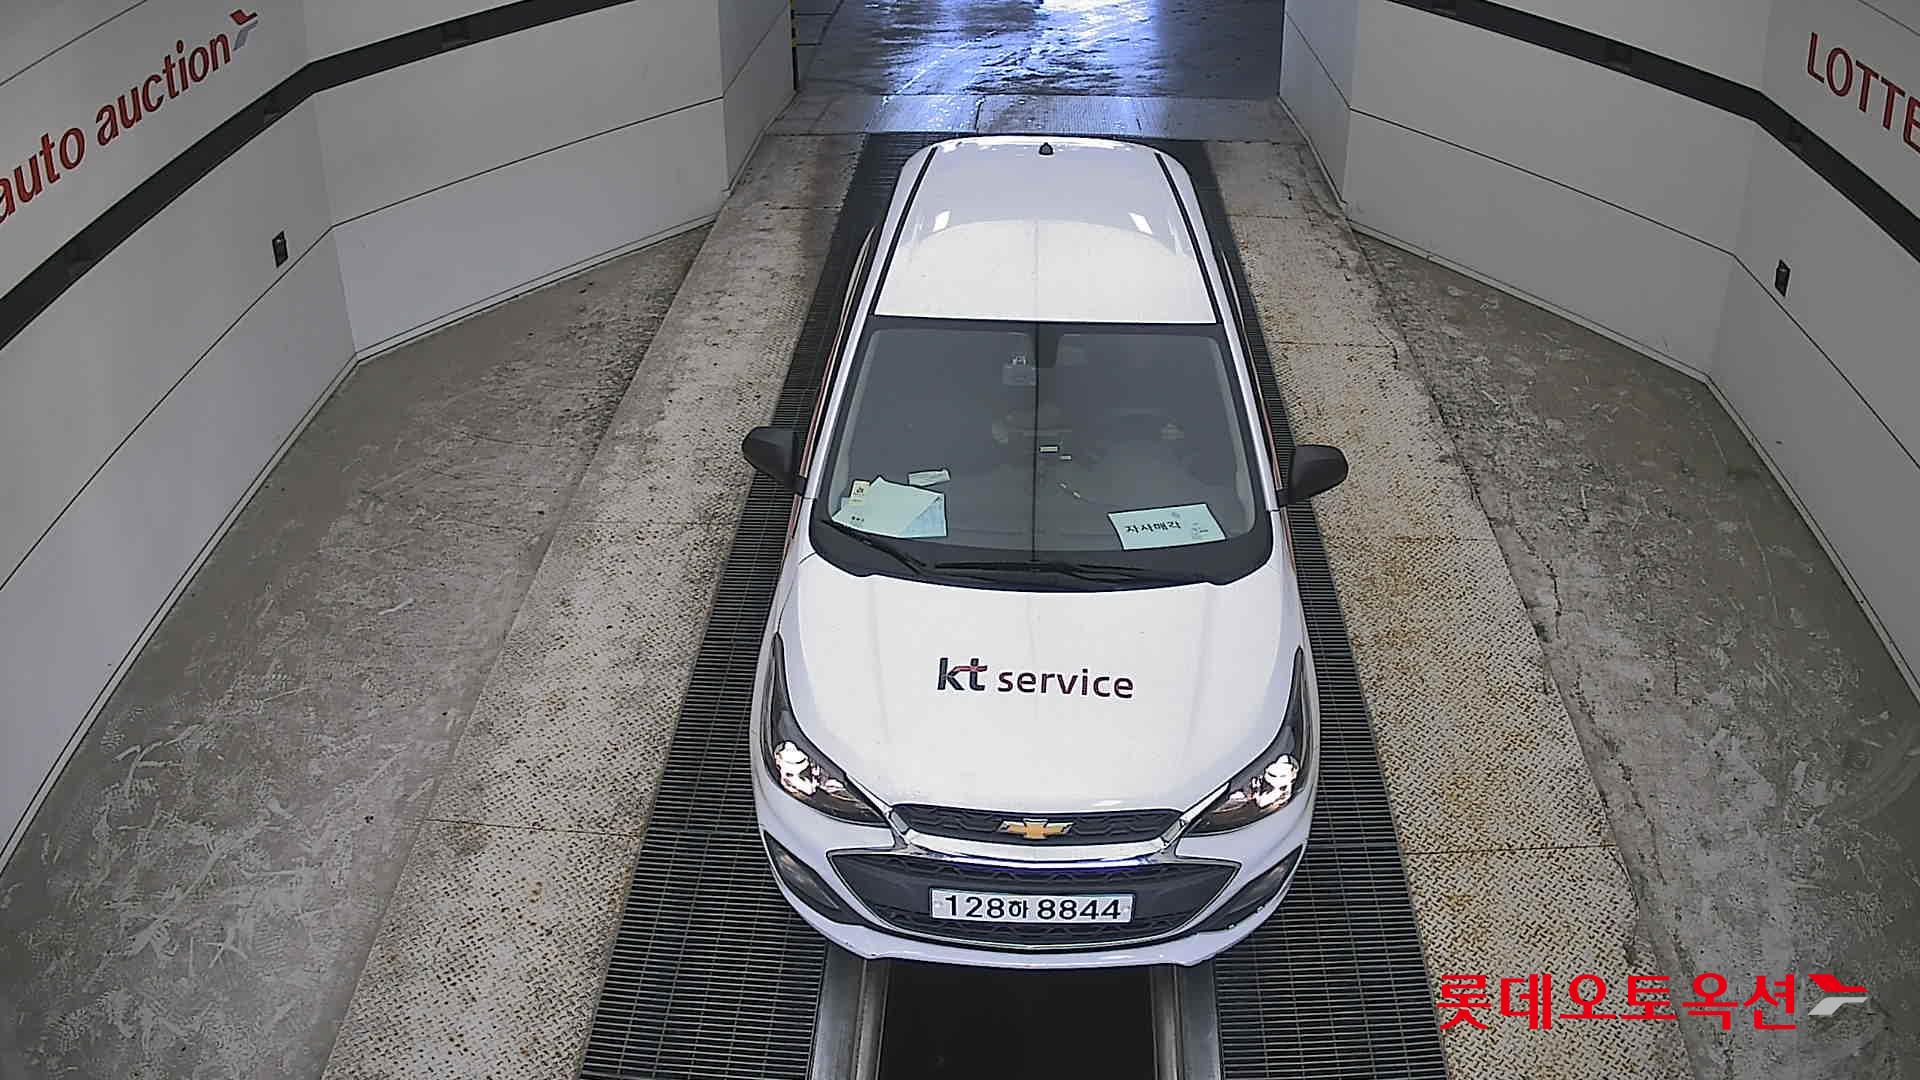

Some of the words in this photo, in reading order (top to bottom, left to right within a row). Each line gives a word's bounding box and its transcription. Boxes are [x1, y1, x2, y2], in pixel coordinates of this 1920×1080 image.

[0, 129, 86, 223] auto
[95, 33, 231, 146] auction
[1807, 32, 1920, 154] LOTTE
[937, 657, 988, 691] kt
[997, 668, 1134, 699] service
[945, 894, 1029, 919] 128하
[1037, 899, 1121, 920] 8844
